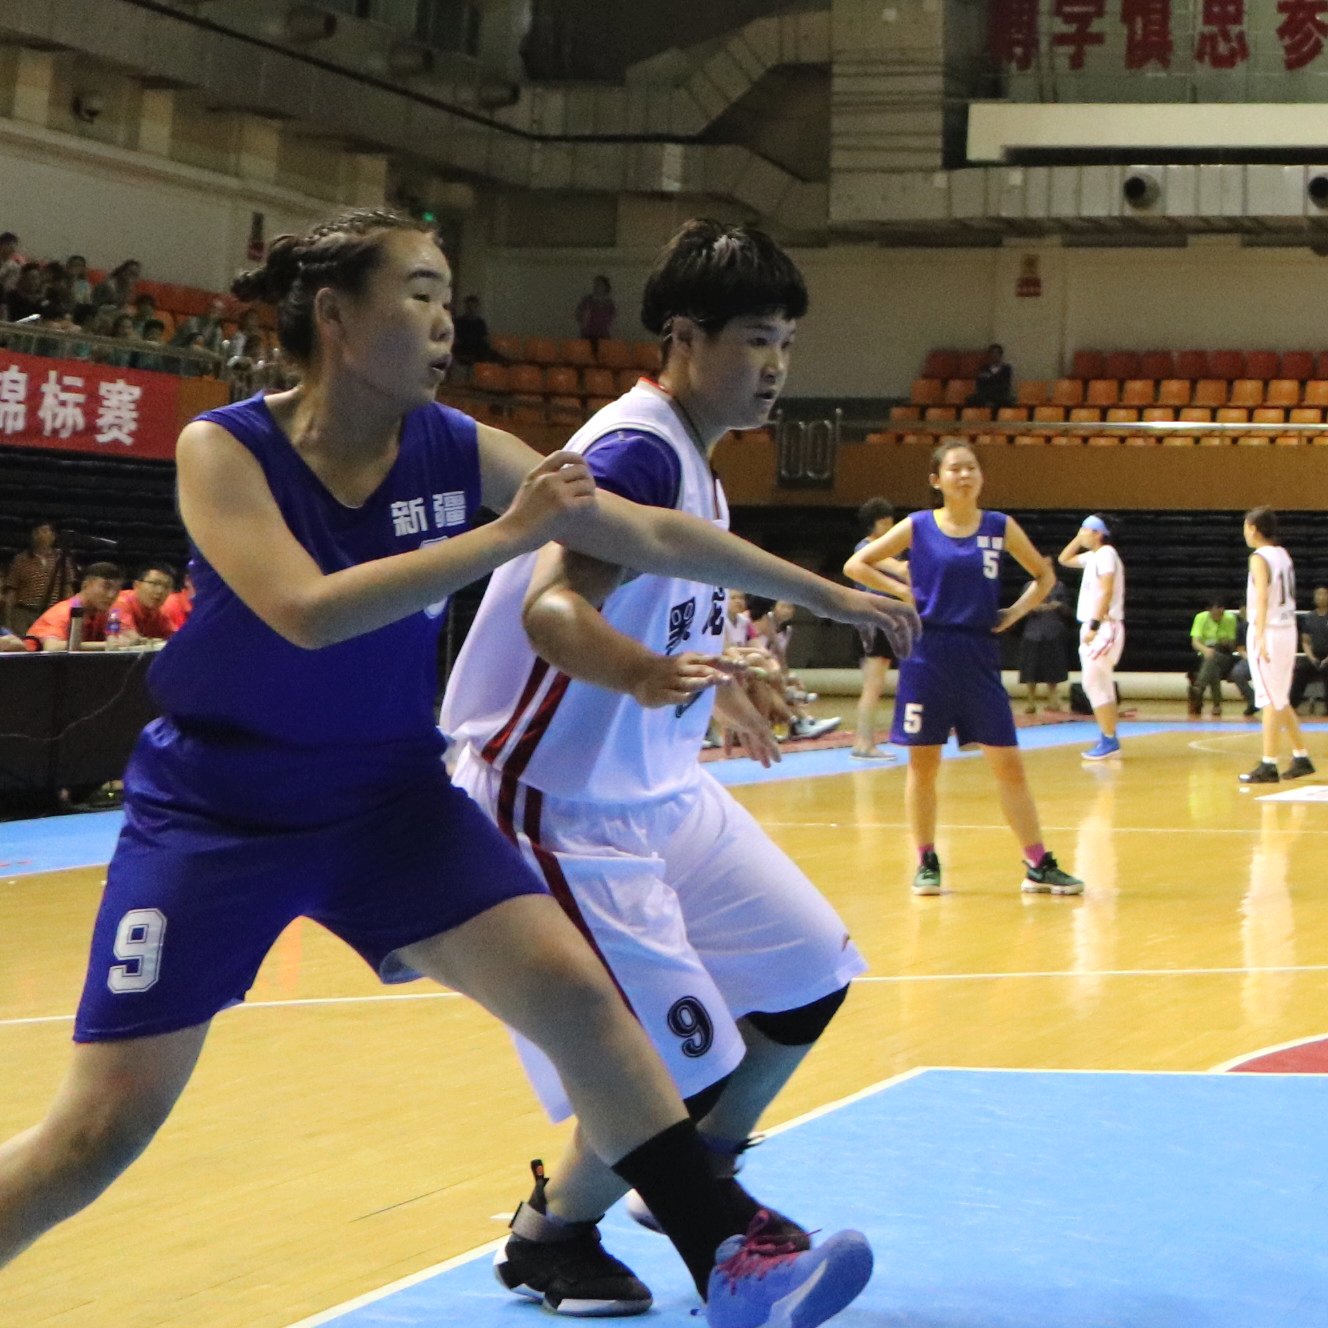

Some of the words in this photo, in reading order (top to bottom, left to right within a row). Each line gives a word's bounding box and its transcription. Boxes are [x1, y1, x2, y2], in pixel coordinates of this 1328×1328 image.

[390, 490, 468, 537] 新疆
[982, 549, 999, 580] 5
[903, 702, 923, 734] 5
[107, 908, 167, 994] 9
[667, 996, 714, 1058] 9
